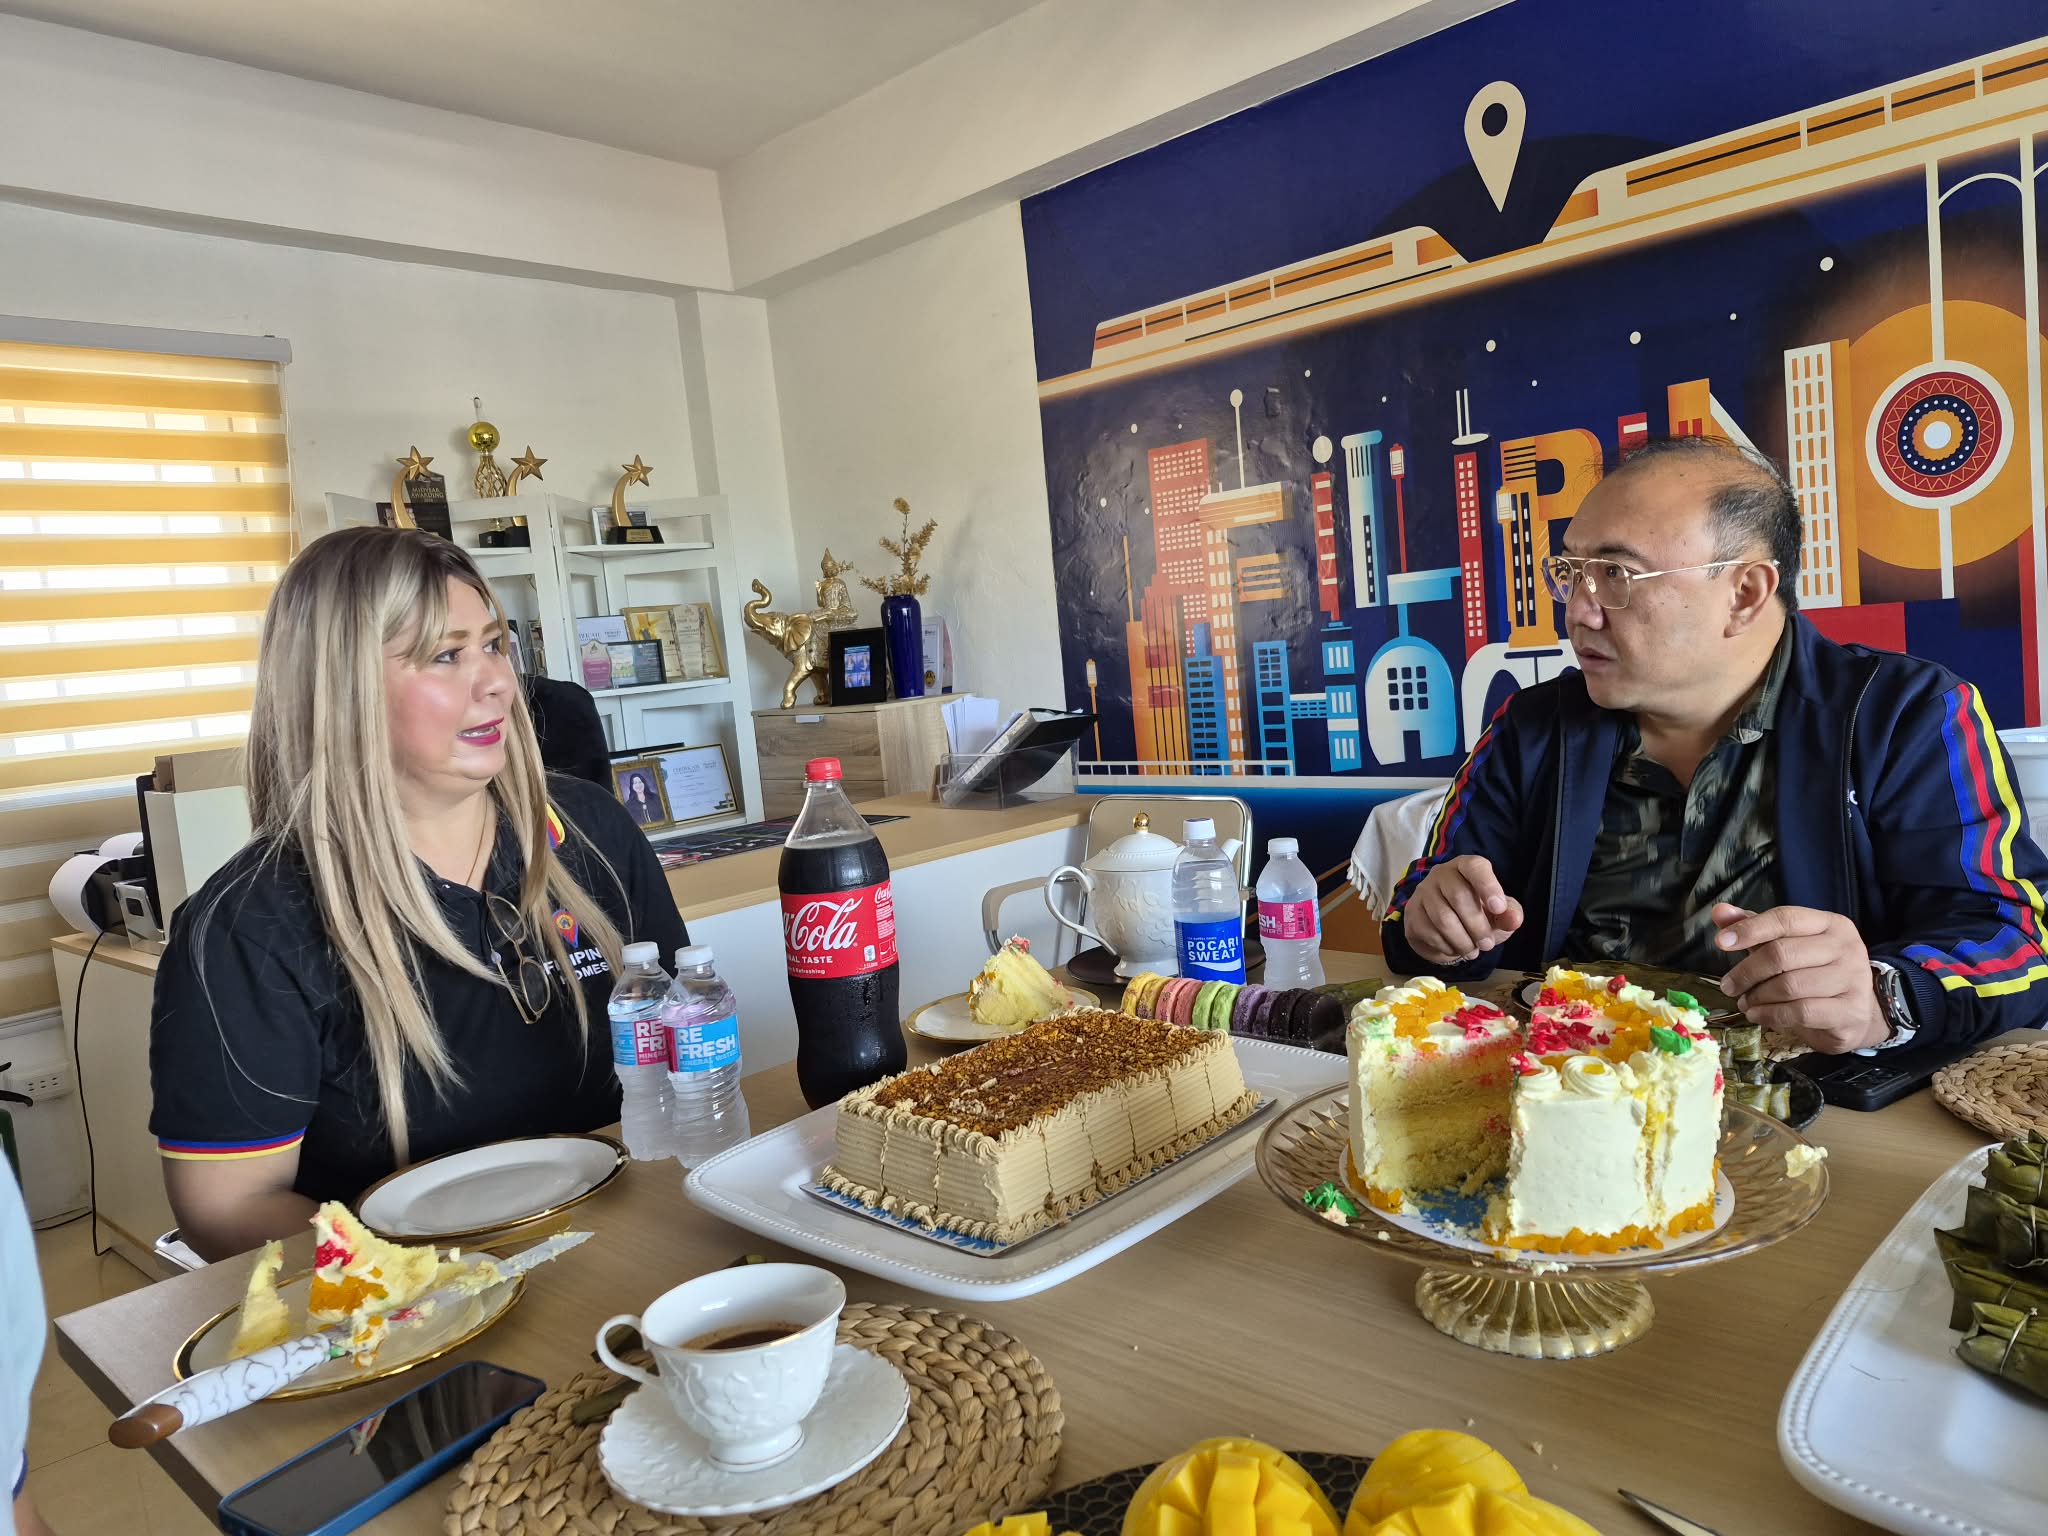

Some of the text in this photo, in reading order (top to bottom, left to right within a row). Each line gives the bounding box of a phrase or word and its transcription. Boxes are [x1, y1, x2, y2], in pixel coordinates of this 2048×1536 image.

[1187, 935, 1239, 952] POCARI
[802, 956, 833, 964] TASTE
[1188, 947, 1236, 962] SWEAT
[636, 1020, 664, 1038] RE
[677, 1027, 704, 1044] RE
[679, 1033, 736, 1061] FRESH
